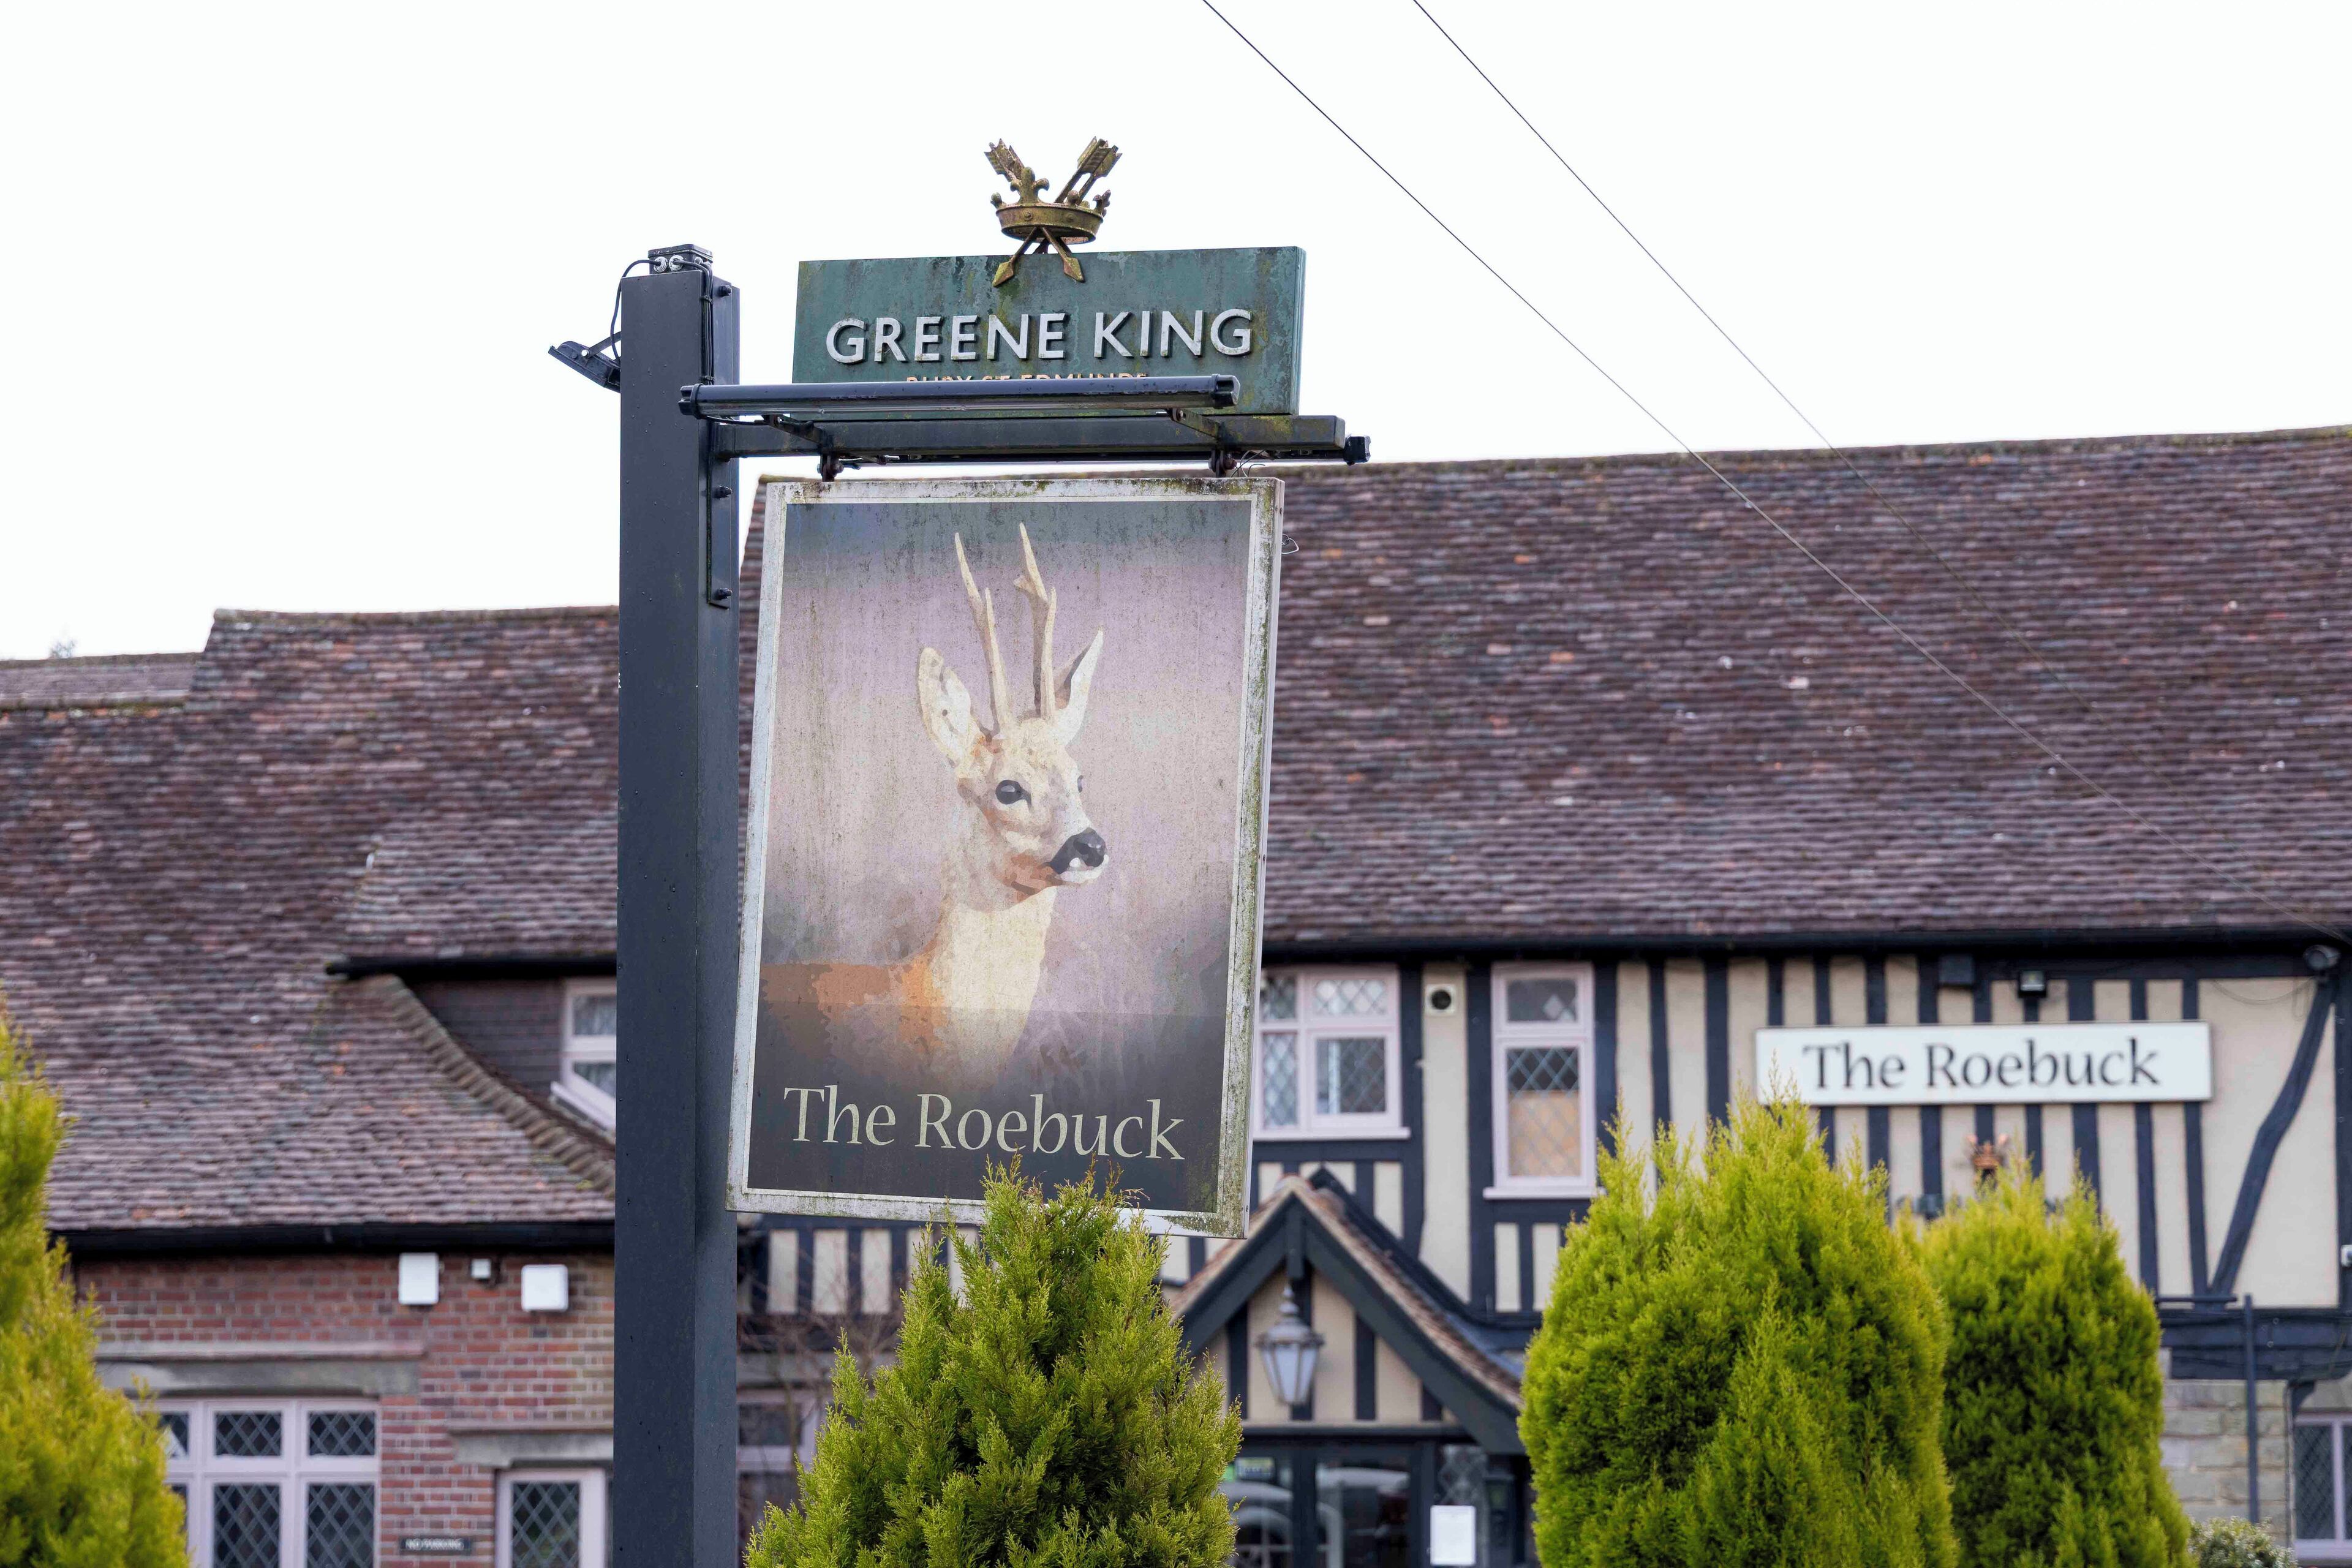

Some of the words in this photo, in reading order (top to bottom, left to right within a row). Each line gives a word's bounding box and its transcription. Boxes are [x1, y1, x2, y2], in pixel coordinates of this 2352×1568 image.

[825, 313, 1066, 364] GREENE
[1093, 307, 1252, 358] KING
[1803, 1041, 1905, 1090] The
[1926, 1037, 2160, 1089] Roebuck
[783, 1085, 896, 1146] The
[914, 1093, 1186, 1160] Roebuck
